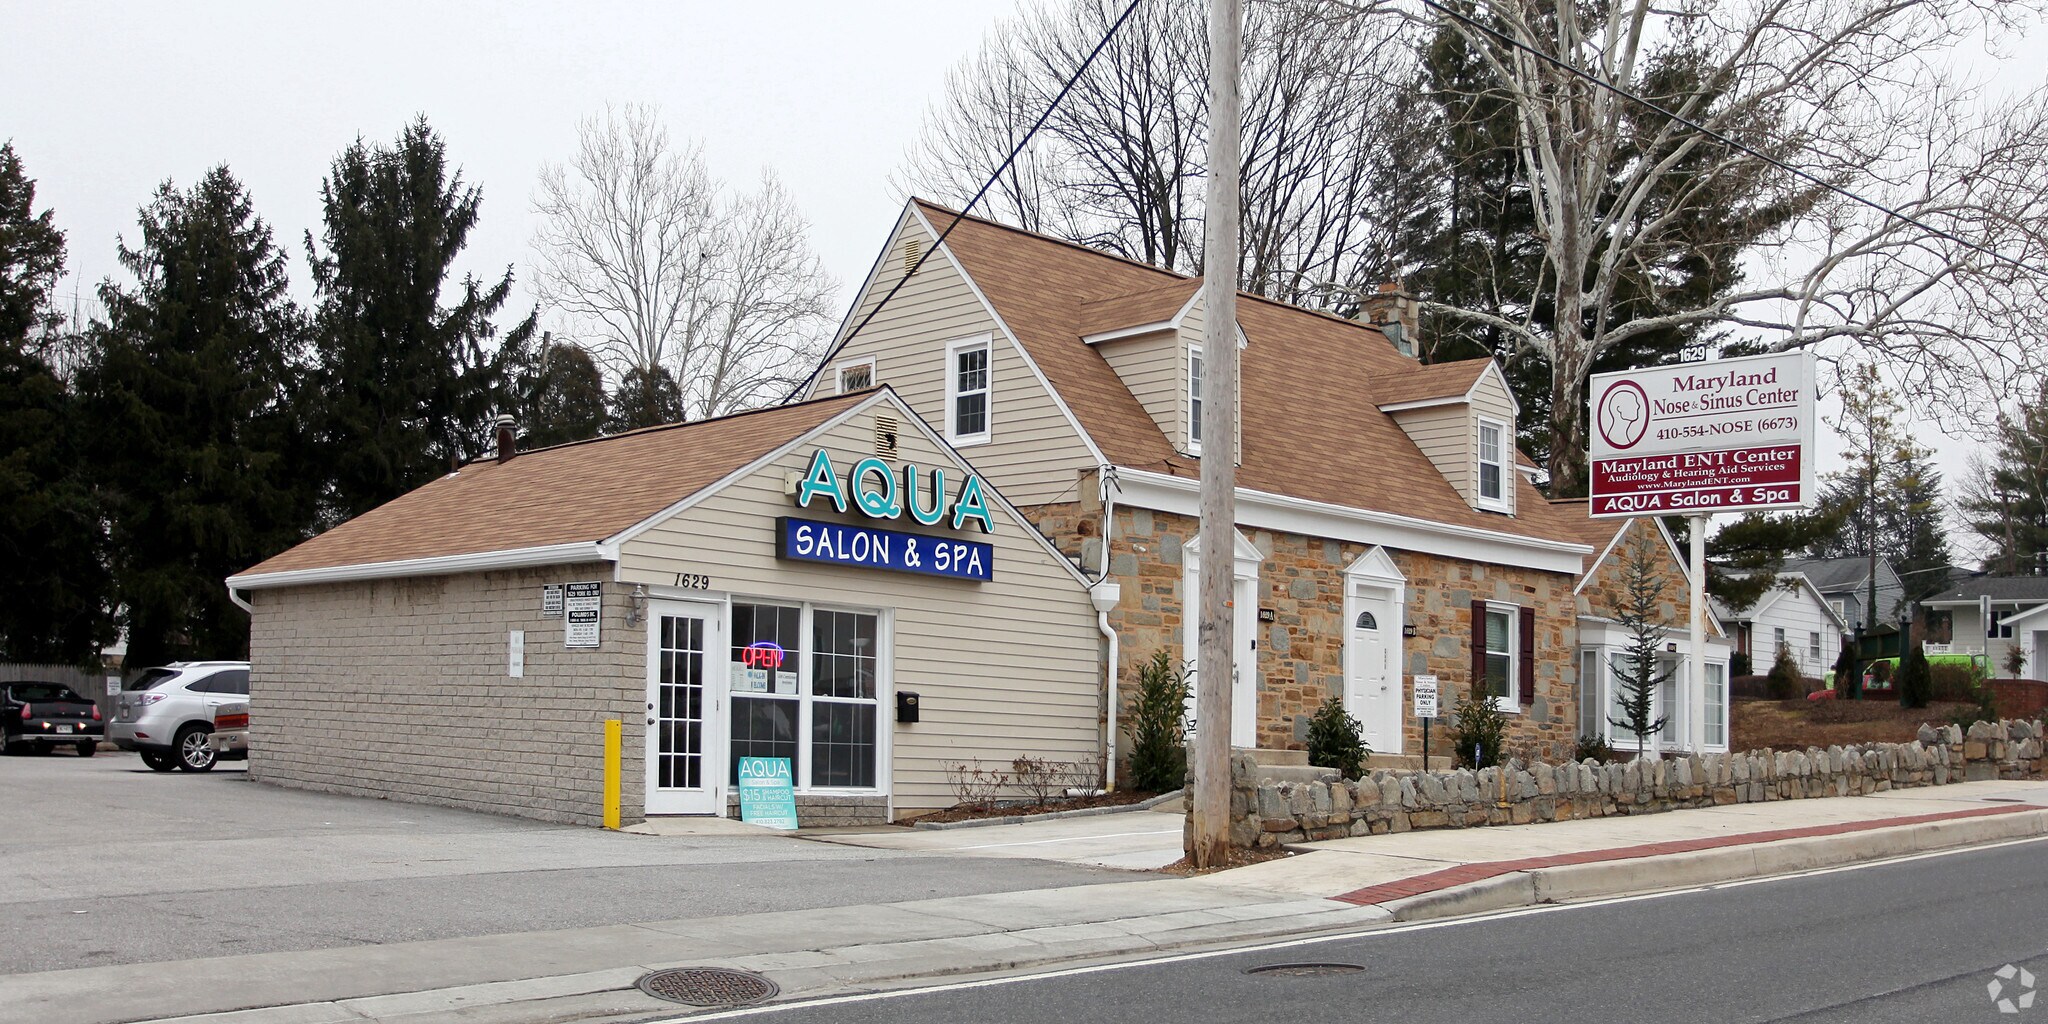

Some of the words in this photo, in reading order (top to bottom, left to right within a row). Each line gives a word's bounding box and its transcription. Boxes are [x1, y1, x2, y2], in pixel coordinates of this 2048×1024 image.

[1678, 346, 1705, 362] 1629
[1672, 367, 1777, 393] Maryland
[1653, 398, 1690, 415] Nose
[1691, 401, 1698, 409] &
[1700, 392, 1743, 410] Sinus
[1746, 387, 1798, 406] Center
[1656, 420, 1752, 440] 410-554-NOSE
[1758, 416, 1798, 433] (6673)
[1601, 456, 1677, 474] Maryland
[1684, 452, 1728, 467] ENT
[1733, 449, 1795, 463] Center
[1608, 472, 1659, 482] Audiology
[1674, 467, 1715, 477] Hearing
[1718, 465, 1737, 474] Aid
[1740, 463, 1785, 473] Services
[1637, 477, 1750, 489] www.MarylandENT.com
[797, 448, 995, 534] AQUA
[1604, 495, 1661, 511] AQUA
[1670, 491, 1720, 507] Salon
[1729, 489, 1742, 503] &
[1752, 488, 1789, 503] Spa
[796, 525, 890, 564] SALON
[904, 538, 921, 567] &
[934, 542, 983, 576] SPA
[674, 573, 709, 590] 1629
[743, 647, 781, 667] OPEN
[740, 760, 789, 777] AQUA
[743, 788, 761, 801] $15
